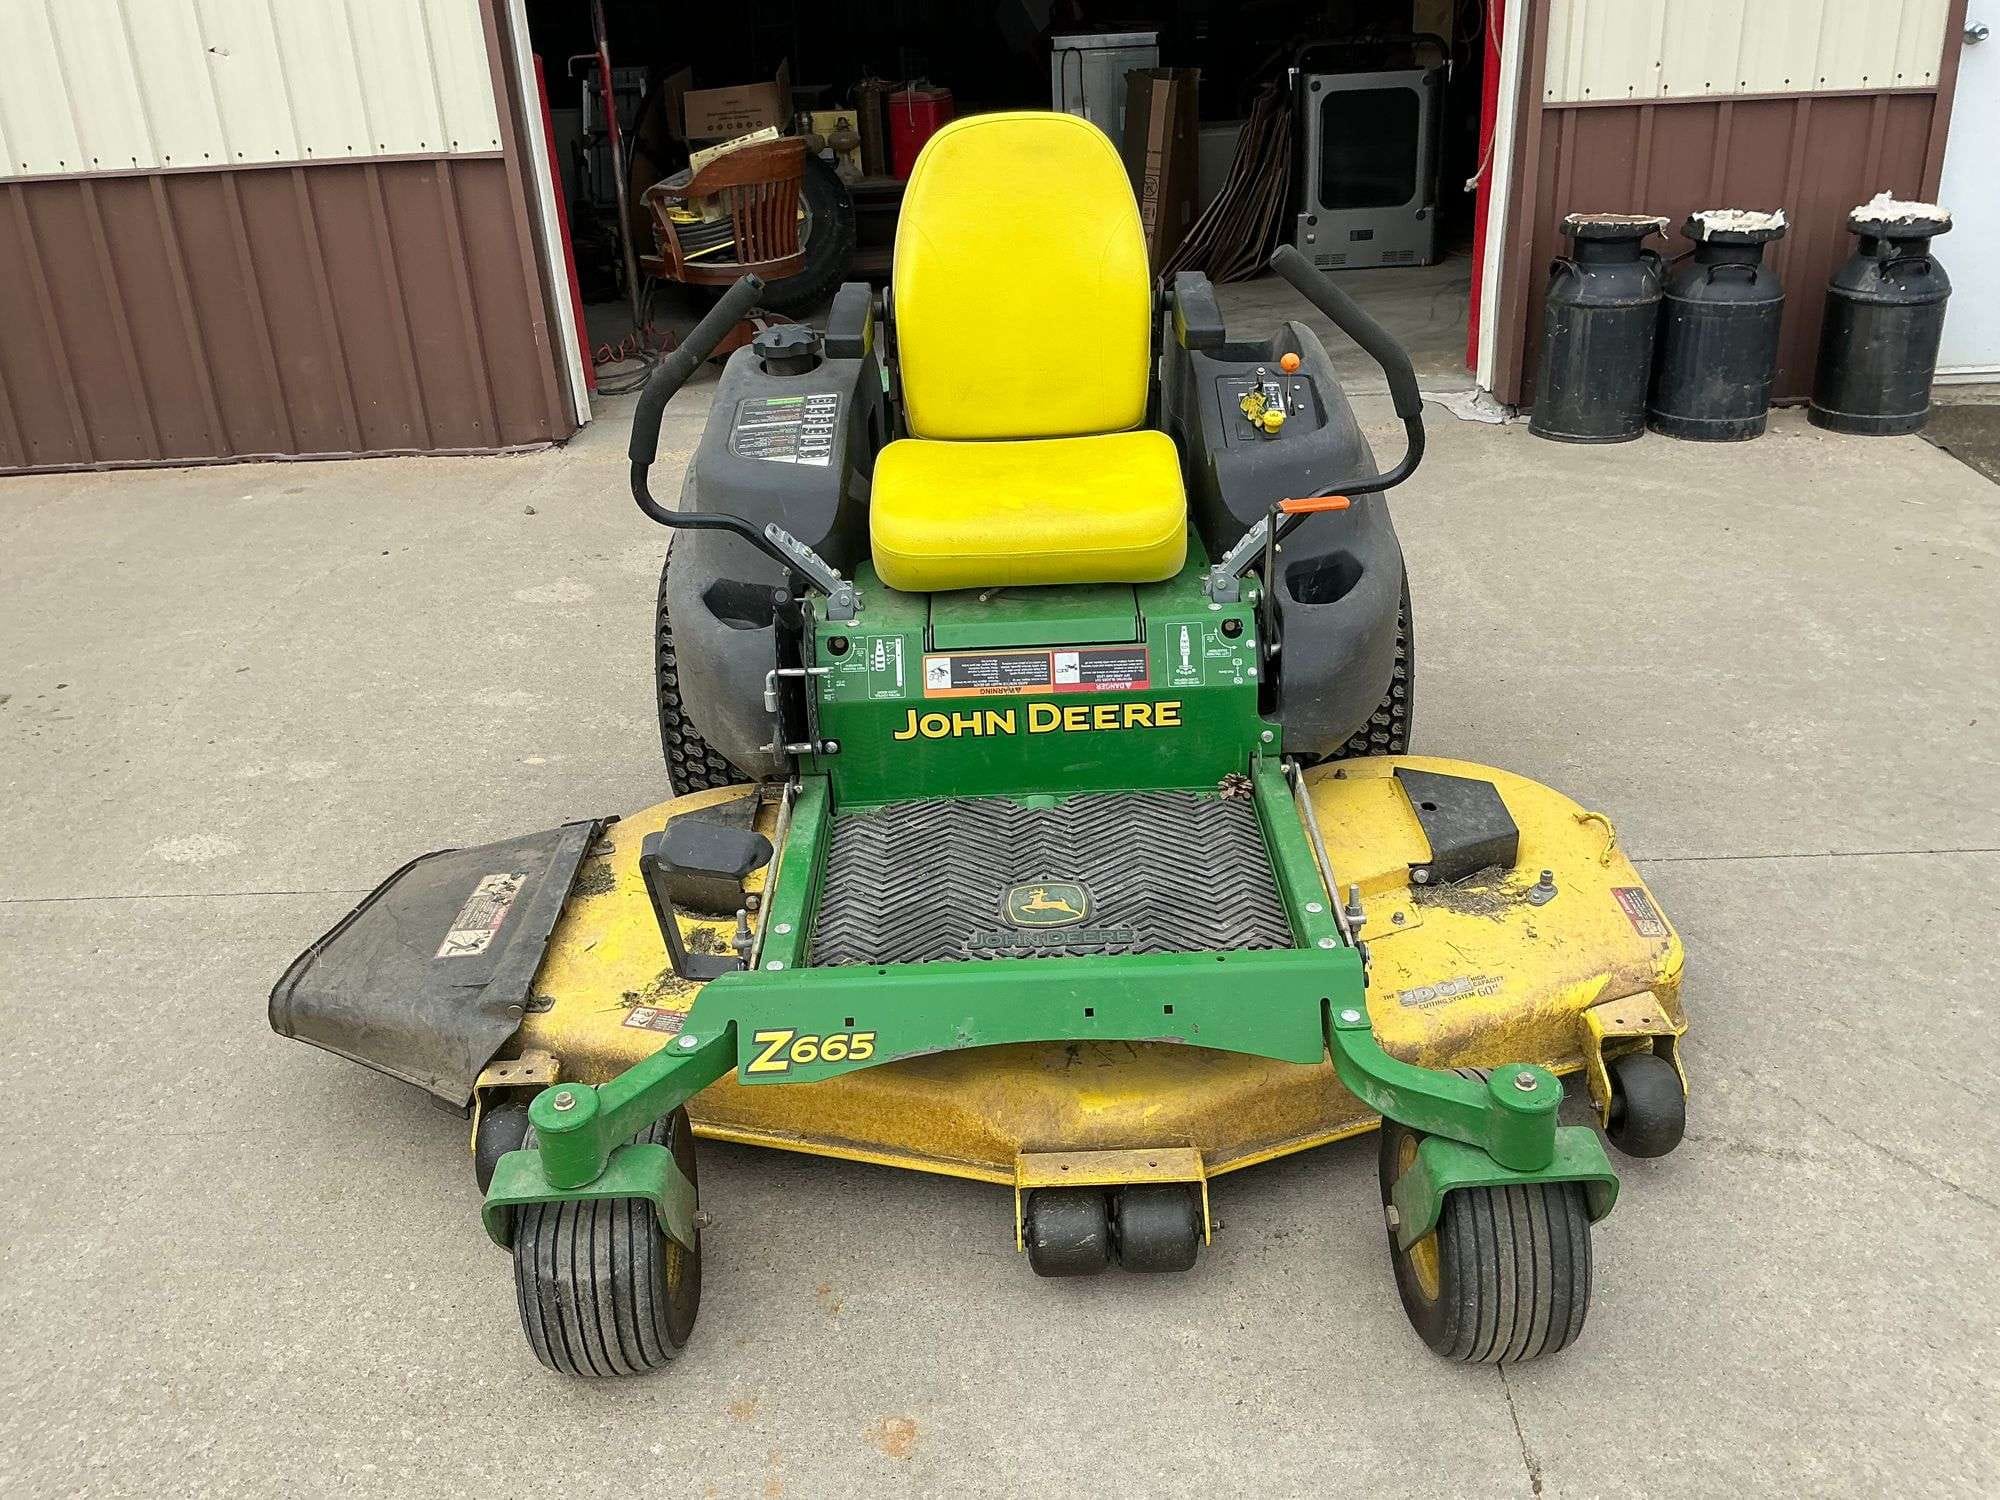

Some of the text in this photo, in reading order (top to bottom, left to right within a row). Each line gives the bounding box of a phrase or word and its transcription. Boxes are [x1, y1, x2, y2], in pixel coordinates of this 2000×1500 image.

[980, 687, 1016, 695] WARNING
[1095, 681, 1125, 690] DANGER
[894, 700, 1182, 741] JOHN DEERE
[968, 929, 1135, 949] JOHN DEERE
[1470, 974, 1487, 983] HIGH
[1472, 975, 1504, 987] CAPACITY
[1418, 998, 1448, 1010] CUTTING
[1448, 992, 1476, 1003] SYSTEM
[745, 1028, 877, 1076] Z665
